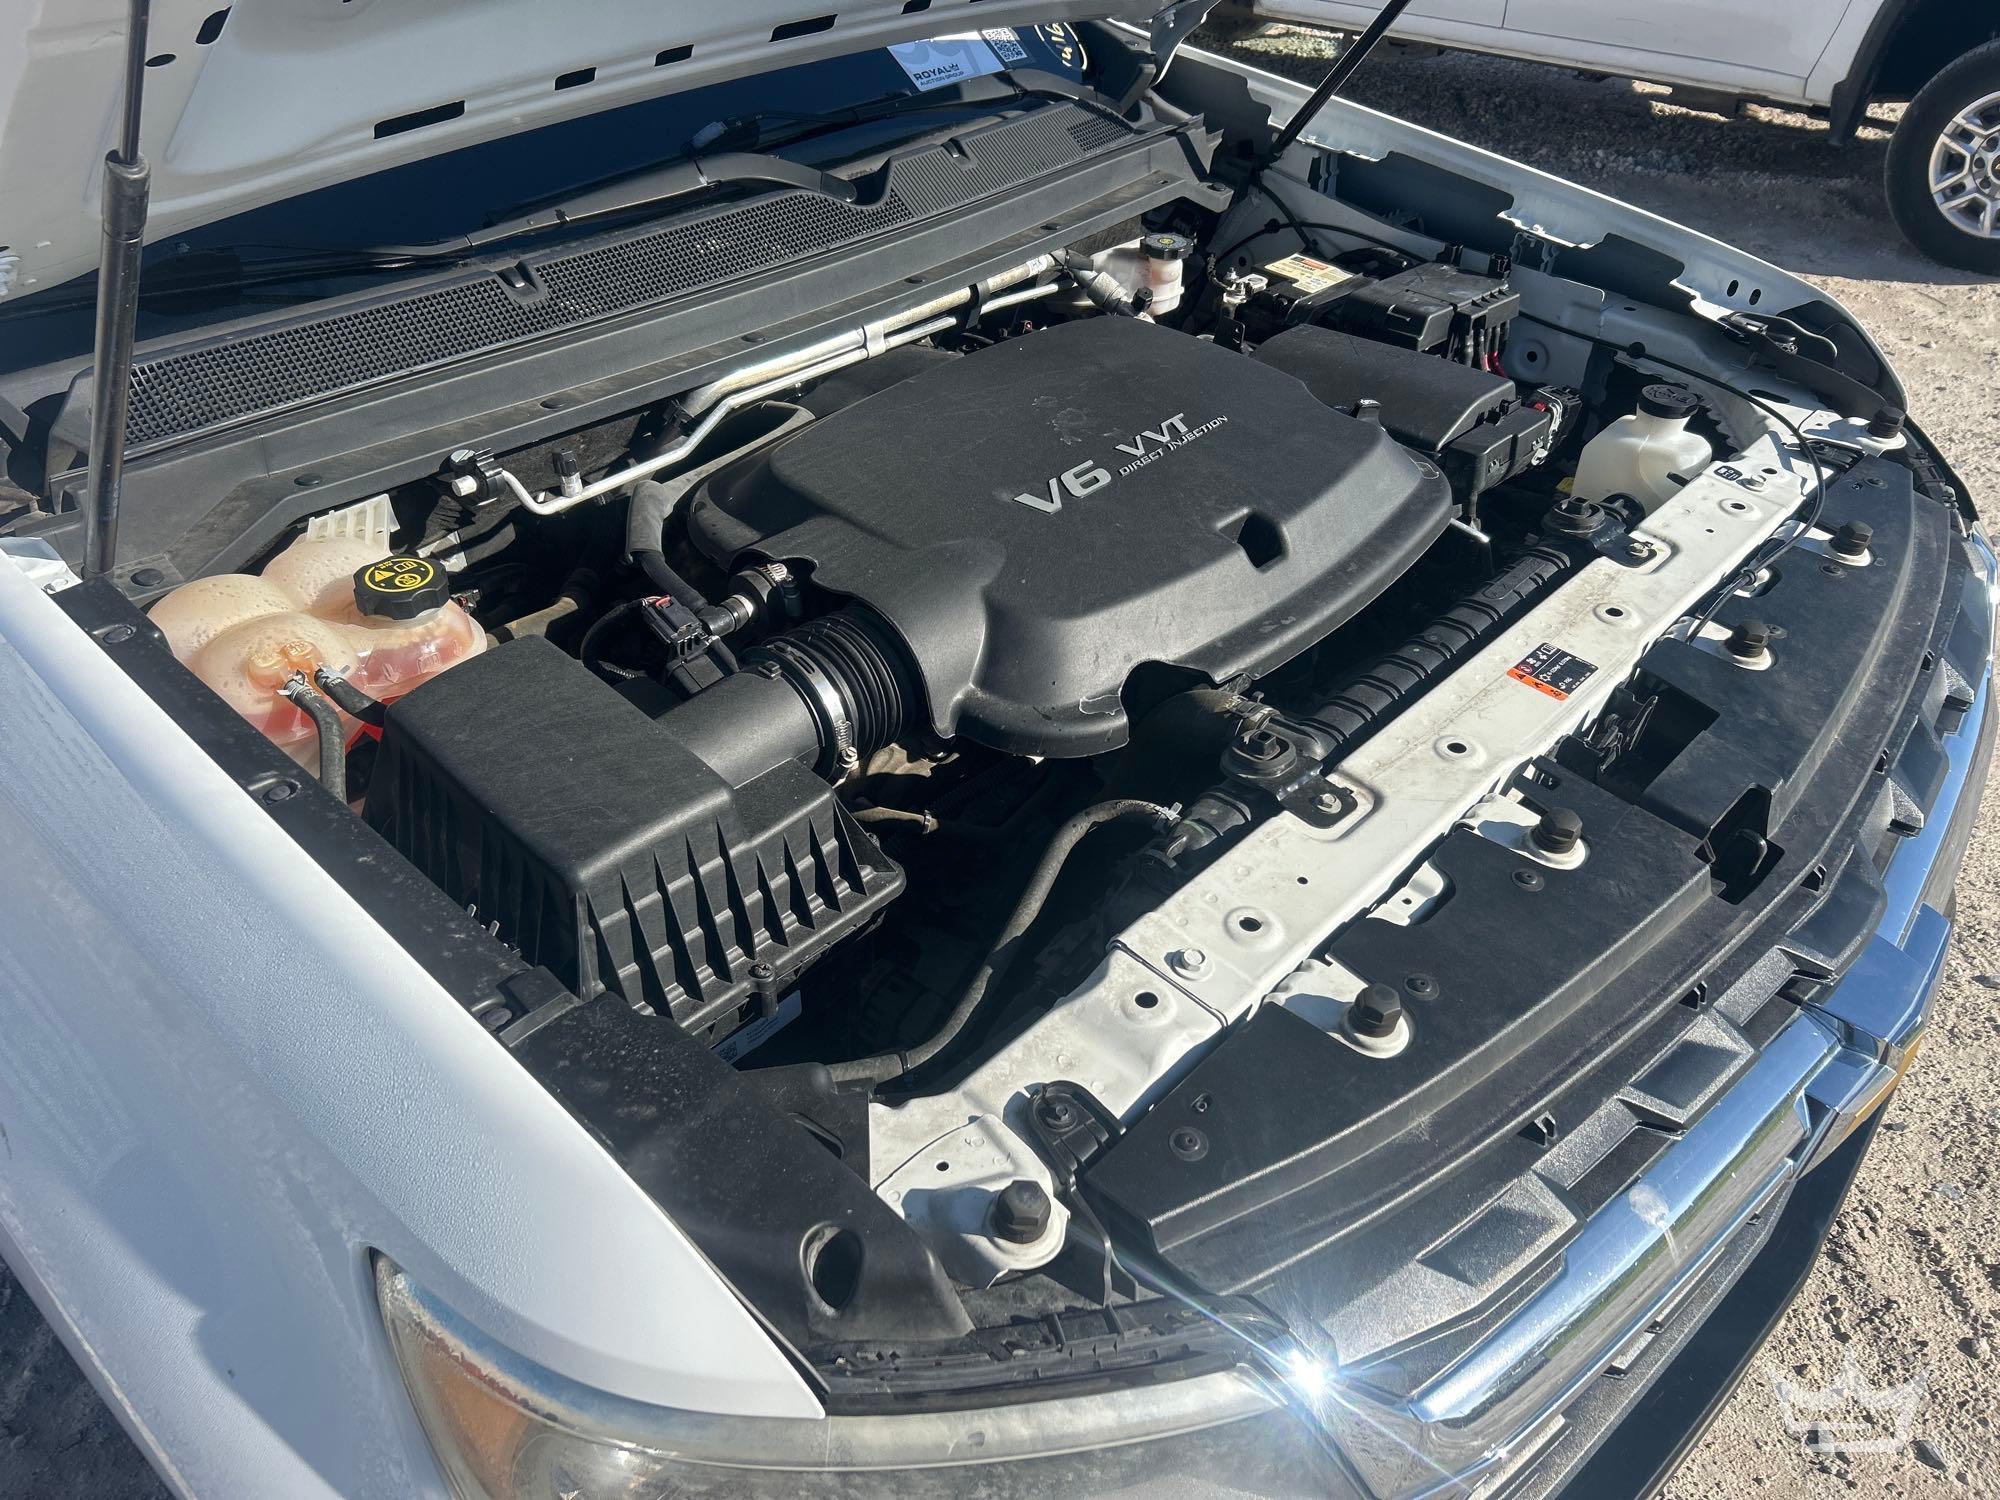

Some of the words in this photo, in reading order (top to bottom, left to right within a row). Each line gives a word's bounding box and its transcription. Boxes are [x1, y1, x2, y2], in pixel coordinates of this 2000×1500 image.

[913, 64, 951, 81] ROYAL
[920, 76, 945, 87] AUCTION
[945, 70, 964, 80] GROUP
[1013, 459, 1112, 515] V6
[1115, 412, 1189, 457] VVT
[1118, 448, 1164, 477] DIRECT
[1167, 415, 1228, 452] INJECTION
